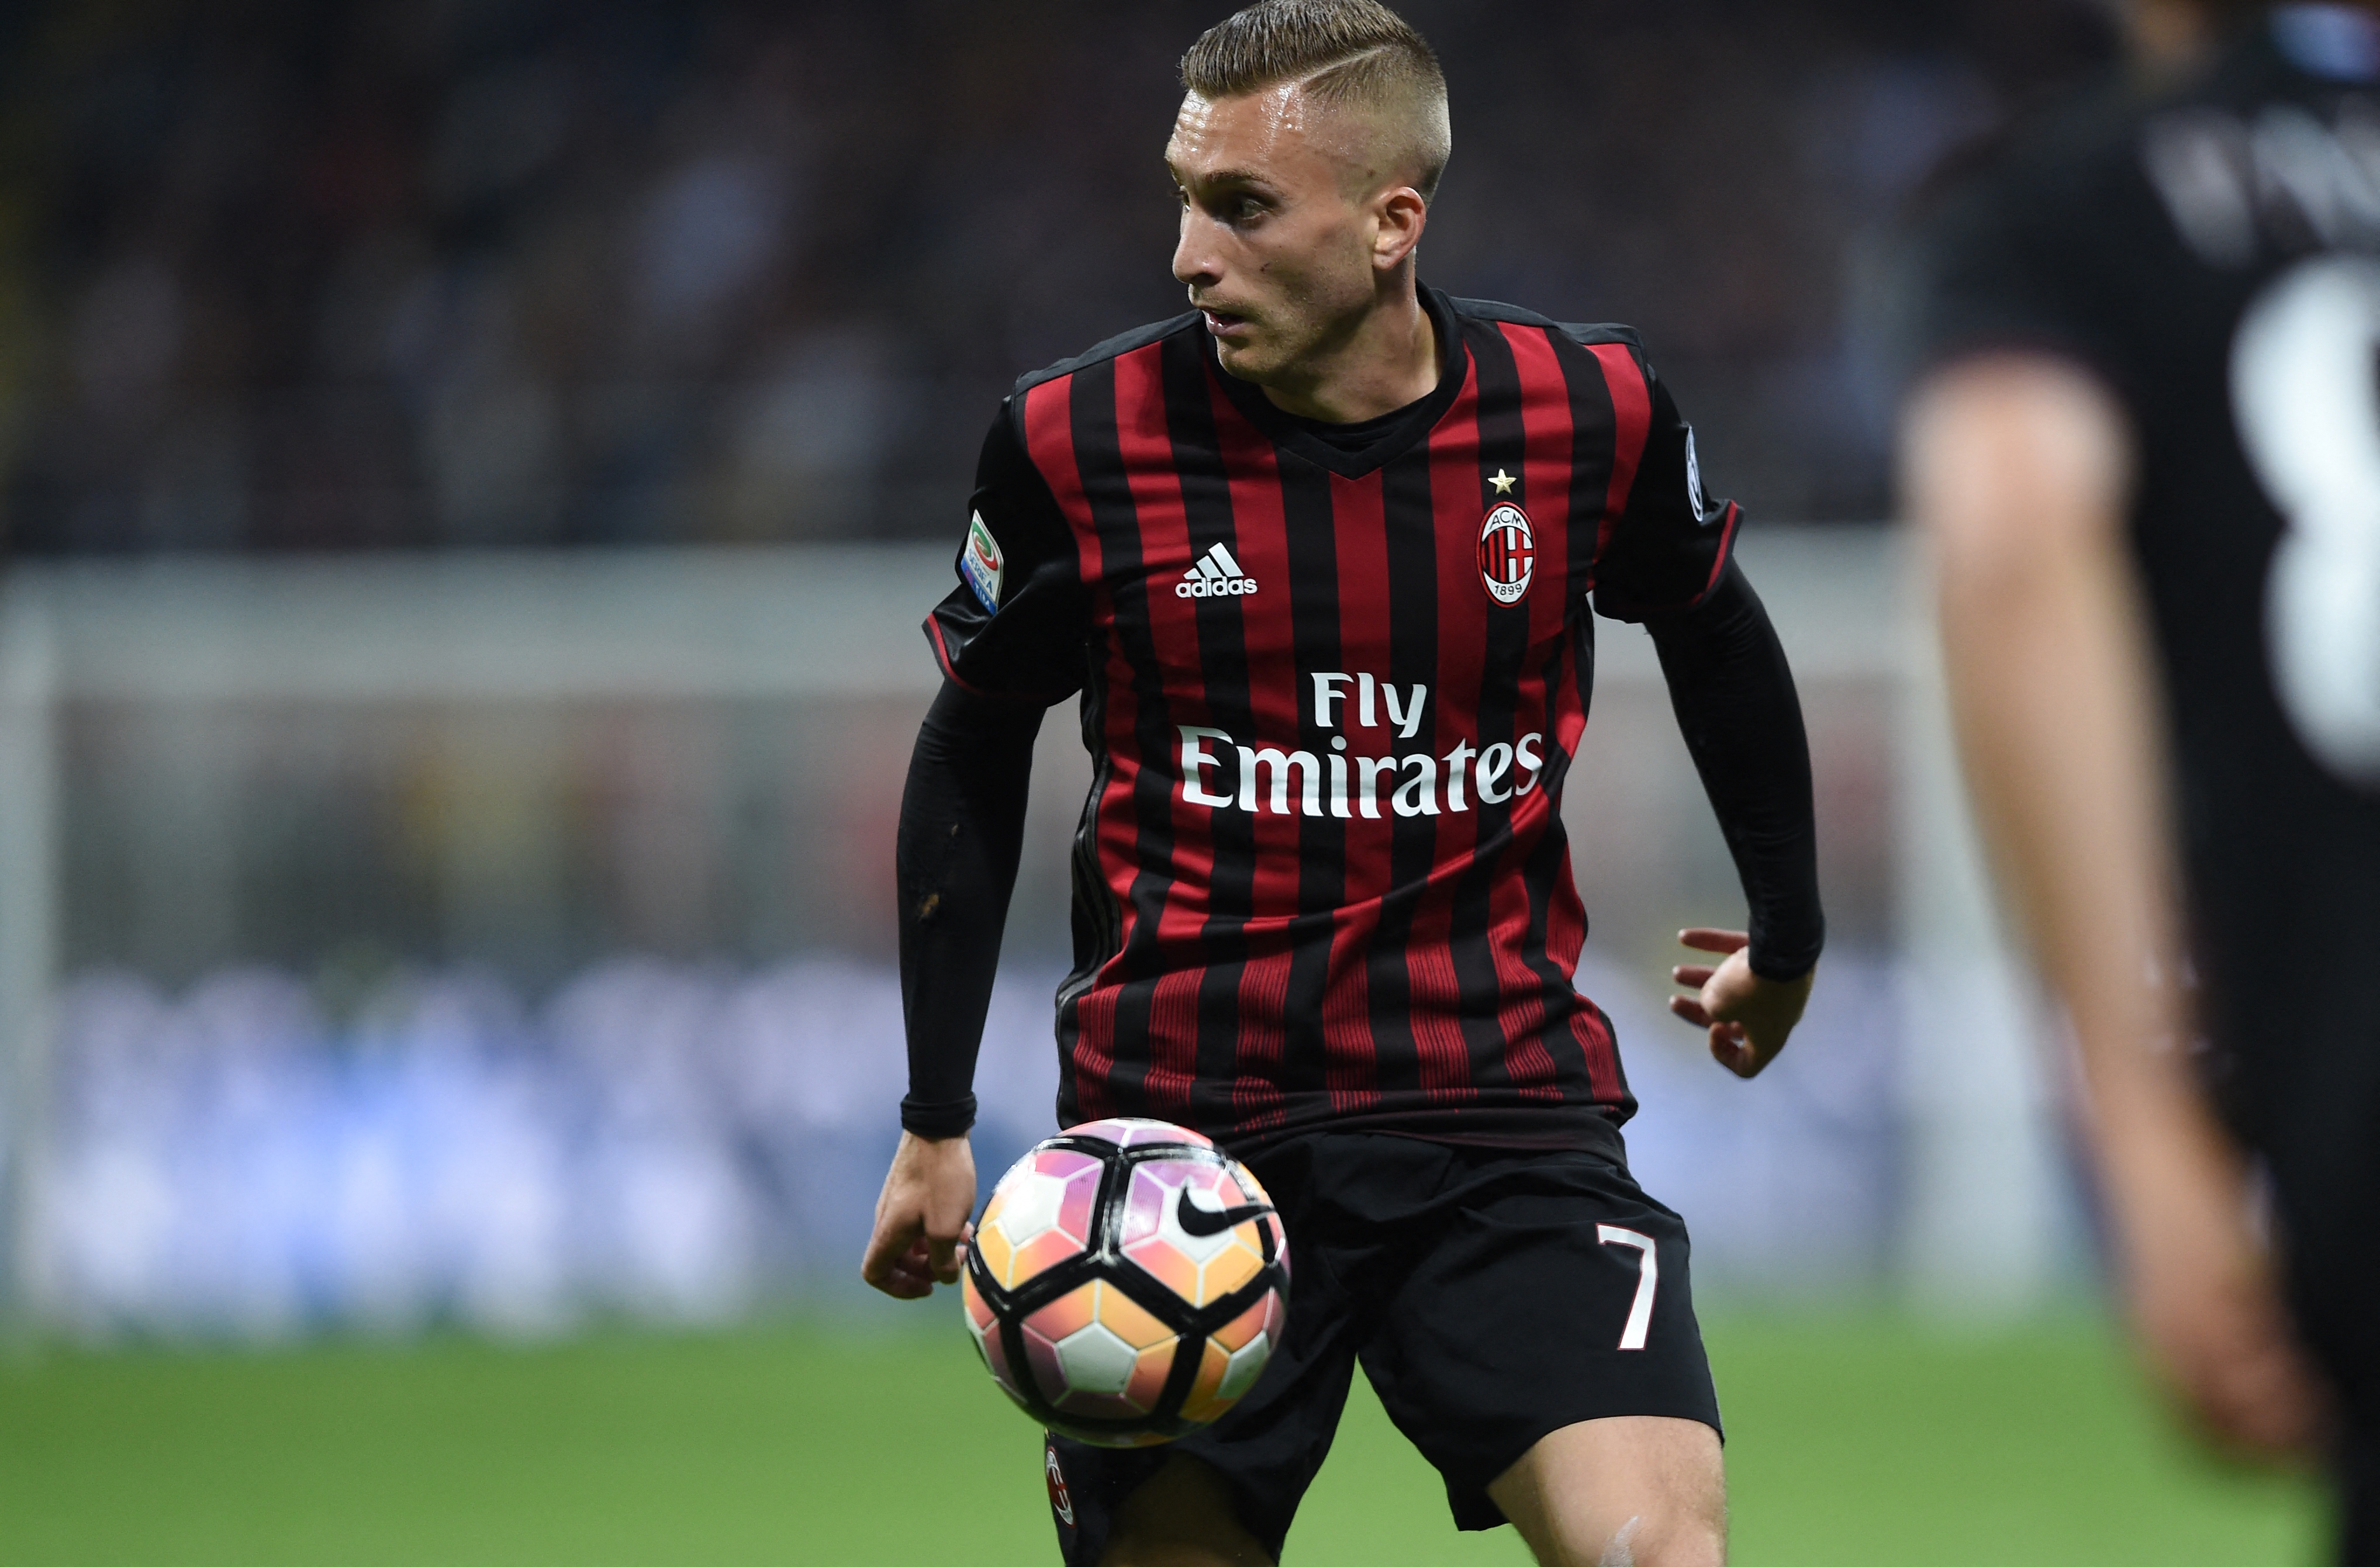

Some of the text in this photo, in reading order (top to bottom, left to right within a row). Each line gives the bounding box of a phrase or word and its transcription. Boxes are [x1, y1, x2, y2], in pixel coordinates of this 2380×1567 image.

[1490, 510, 1524, 529] ACM
[1175, 576, 1258, 599] adidas
[1494, 584, 1522, 596] 1899
[1310, 672, 1428, 738] Fly
[1176, 725, 1543, 819] Emirates
[1595, 1222, 1659, 1351] 7
